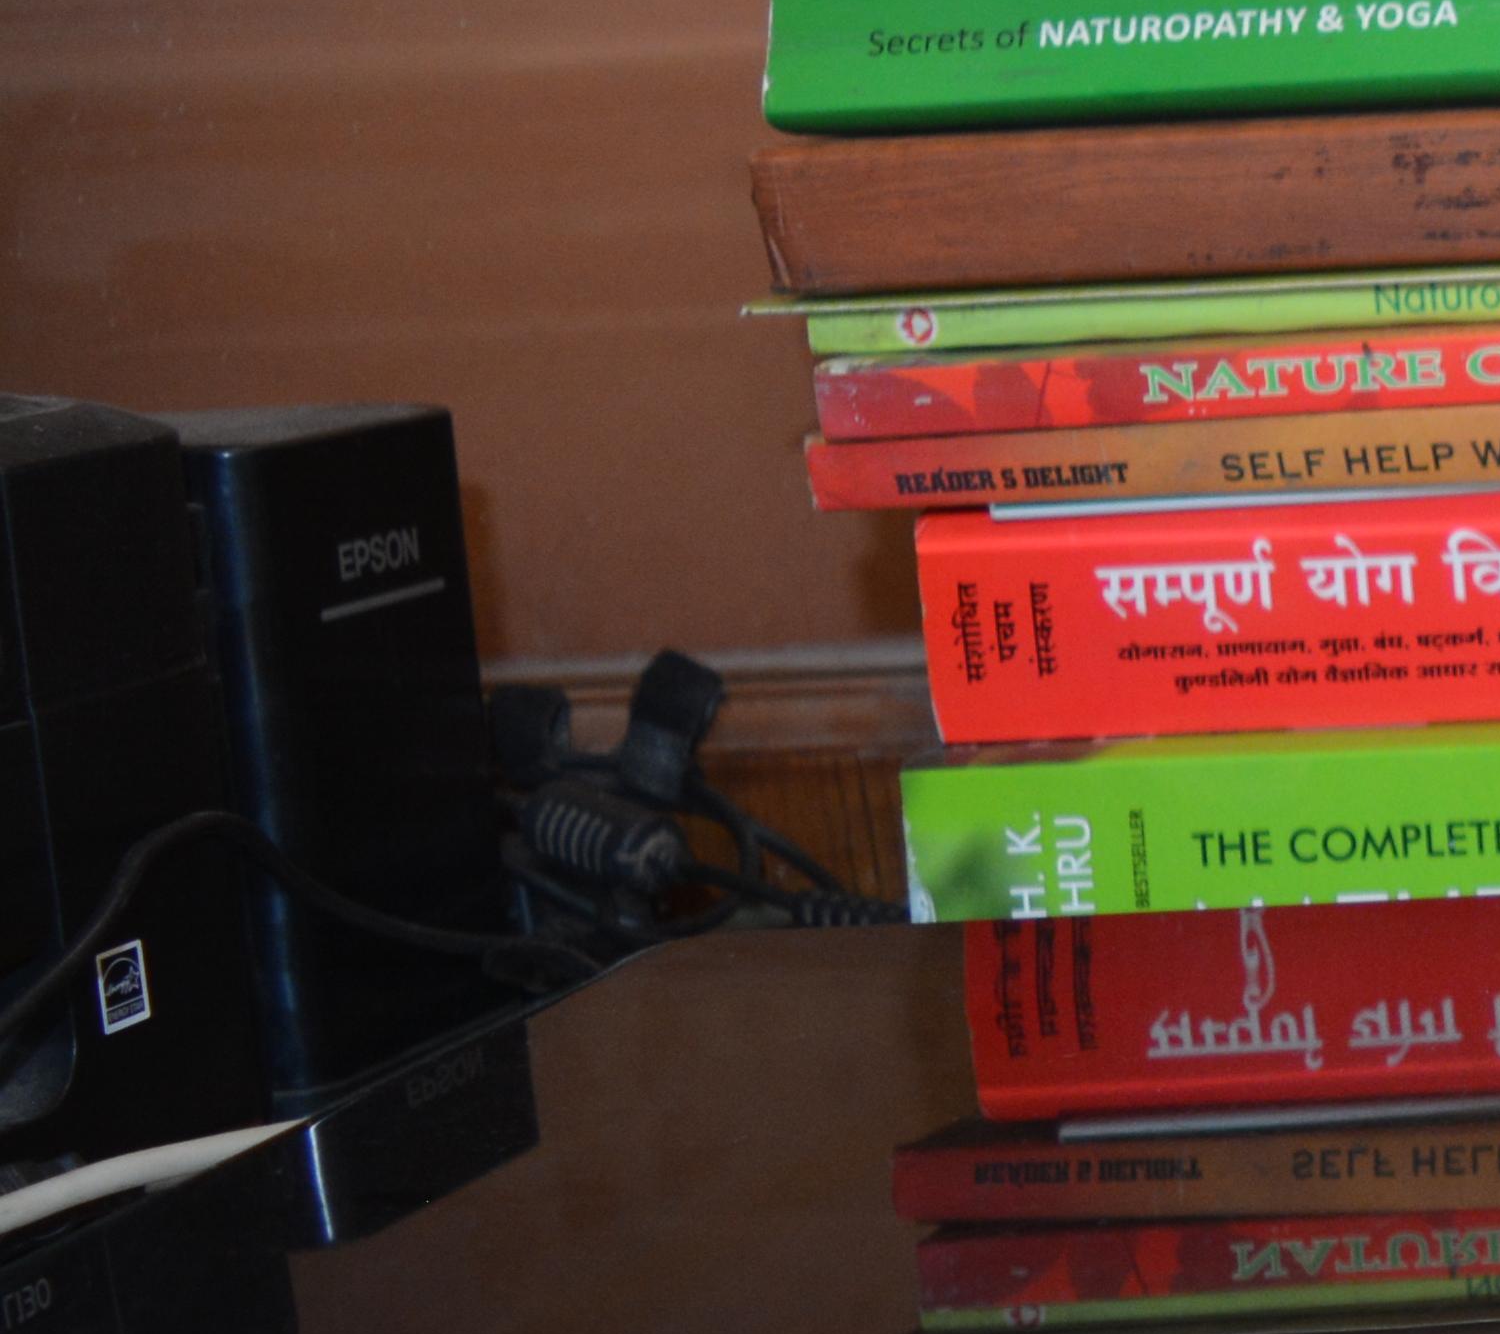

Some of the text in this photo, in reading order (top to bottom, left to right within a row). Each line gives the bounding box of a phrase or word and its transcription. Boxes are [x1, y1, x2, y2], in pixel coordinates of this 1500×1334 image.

[868, 25, 985, 59] Secrets
[993, 18, 1036, 51] of
[1038, 5, 1309, 50] NATUROPATHY
[1316, 4, 1345, 33] &
[1141, 347, 1444, 406] NATURE
[1220, 449, 1325, 483] SELF
[1342, 440, 1457, 475] HELP
[337, 527, 421, 582] EPSON
[1094, 539, 1276, 633] सम्पूर्ण
[1300, 534, 1417, 606] योग
[1004, 810, 1042, 855] K.
[1192, 830, 1273, 867] THE
[1053, 815, 1096, 913] HRU
